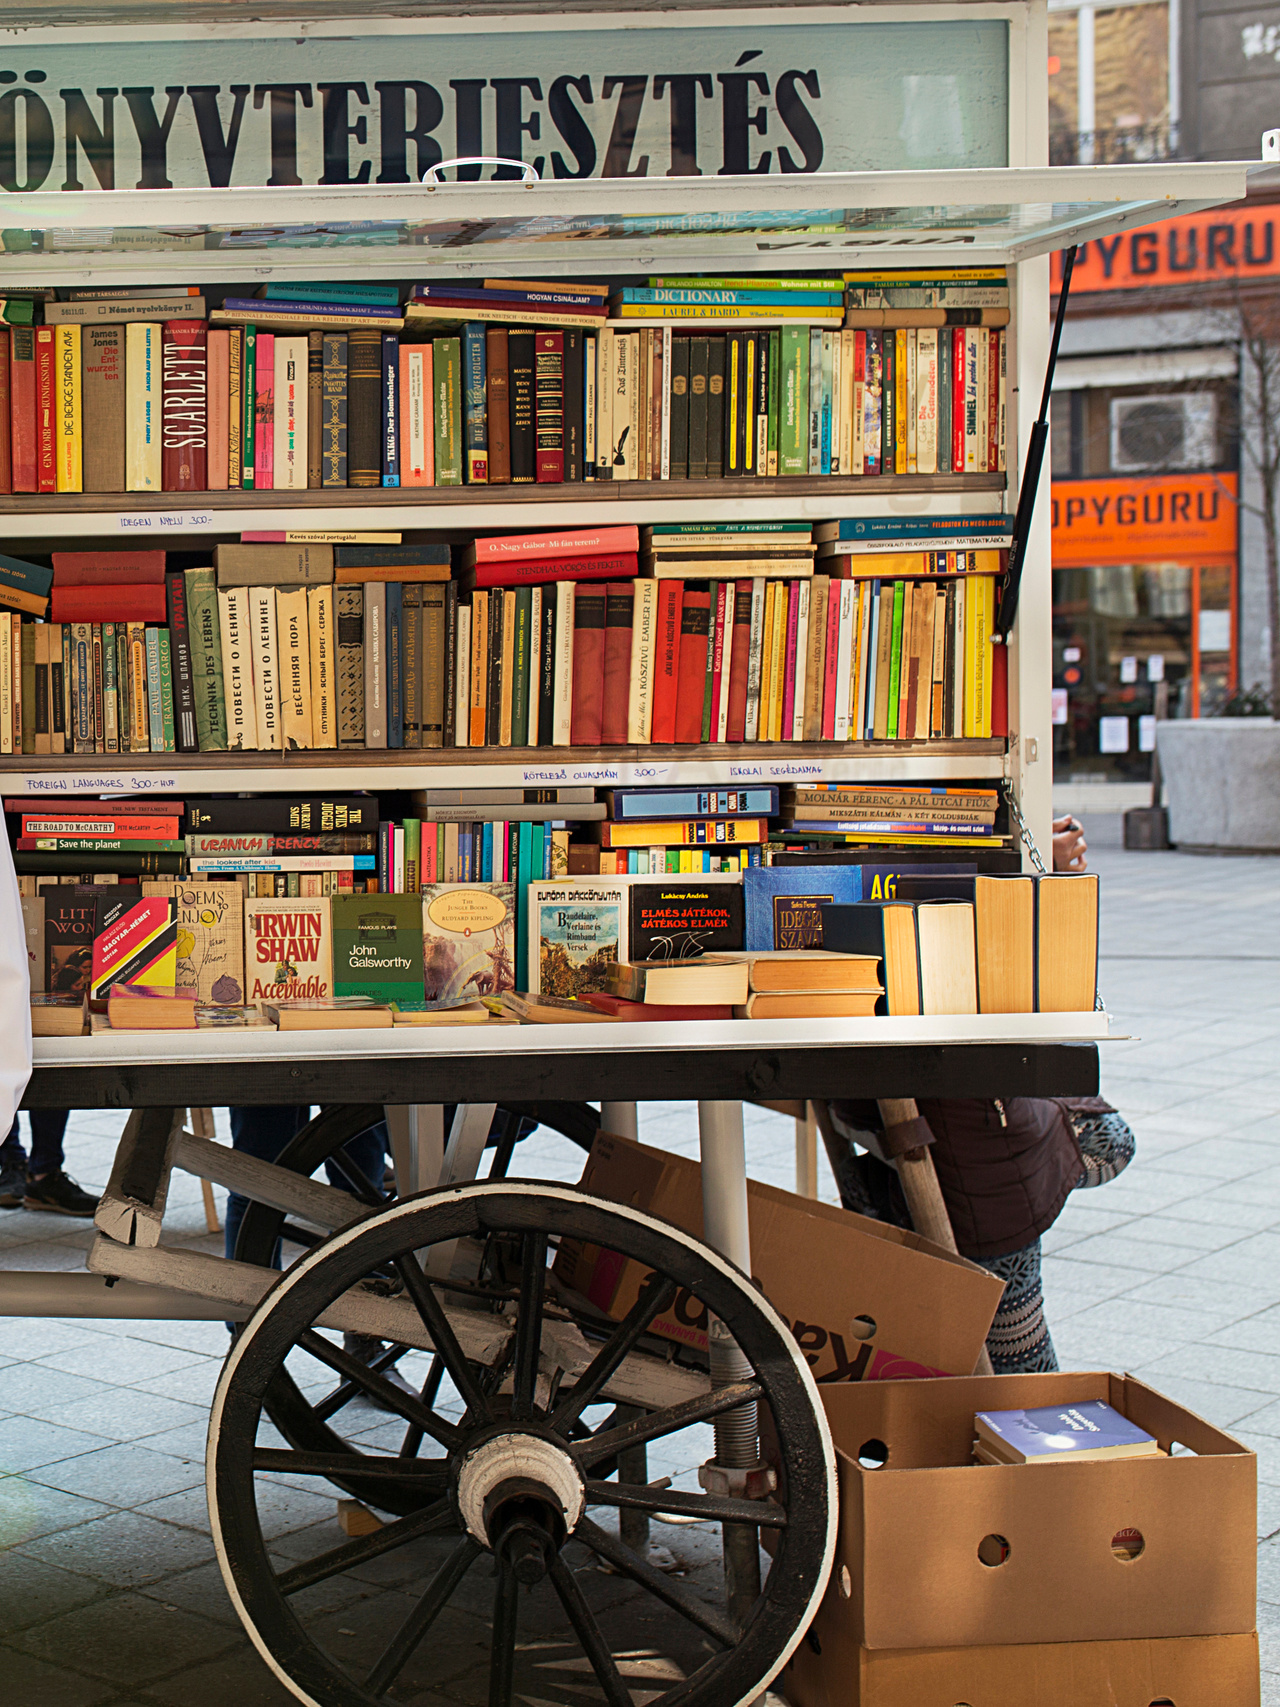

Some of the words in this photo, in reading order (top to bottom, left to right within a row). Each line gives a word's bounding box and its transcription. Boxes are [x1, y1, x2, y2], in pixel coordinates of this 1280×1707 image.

[1050, 219, 1274, 284] PYGURU
[527, 293, 552, 301] HOGYAN
[553, 294, 590, 304] CSINÁLJAM?
[654, 289, 739, 303] DICTIONARY
[90, 330, 118, 339] James
[93, 339, 118, 347] Jones
[103, 347, 118, 355] Die
[101, 355, 118, 363] Ent-
[87, 365, 118, 373] wurzel-
[104, 372, 118, 380] ten
[163, 342, 206, 448] SCARLETT
[967, 399, 976, 435] SIMMEL
[120, 516, 151, 526] IDEGEN
[160, 516, 183, 527] NYELV
[501, 542, 520, 553] Nagy
[522, 540, 546, 551] Gábor
[549, 539, 560, 548] Mi
[561, 538, 573, 548] fán
[574, 537, 600, 547] terem?
[642, 583, 651, 604] FIAI
[172, 578, 185, 631] УРАГАН
[227, 595, 239, 645] ЛЕНИНЕ
[641, 606, 651, 642] EMBER
[202, 608, 213, 649] LEBENS
[289, 616, 299, 648] ПОРА
[178, 644, 188, 680] ШПАНОВ
[205, 655, 215, 675] DES
[639, 646, 648, 689] KŐSZÍVŰ
[291, 656, 303, 715] ВЕСЕННЯЯ
[180, 685, 190, 706] НИК.
[232, 666, 244, 725] ПОВЕСТИ
[206, 681, 220, 733] TECHNIK
[524, 770, 568, 781] KÖTELEZŐ
[730, 767, 762, 776] ISKOLAI
[770, 765, 823, 776] SEGÉDANYAG
[26, 779, 67, 790] FOREIGN
[72, 779, 124, 788] LANGUAGES
[804, 792, 849, 804] MOLNÁR
[853, 795, 894, 805] FERENC
[899, 796, 906, 805] A
[910, 794, 929, 806] PÁL
[932, 797, 962, 806] UTCAI
[965, 797, 990, 807] FIÚK
[290, 806, 299, 827] SMITH
[301, 803, 311, 830] MURRAY
[321, 801, 334, 831] JUGGLER
[335, 804, 347, 828] DEVILS
[349, 808, 361, 824] THE
[28, 823, 42, 831] THE
[43, 823, 63, 831] ROAD
[64, 823, 74, 831] TO
[75, 823, 113, 832] McCARTHY
[59, 840, 79, 848] Save
[80, 840, 94, 848] the
[95, 840, 121, 850] planet
[200, 838, 263, 852] URANIUM
[266, 836, 321, 850] FRENZY
[174, 884, 224, 905] POEMS
[537, 889, 566, 901] EURÓPA
[661, 892, 686, 900] Lukácsy
[686, 892, 709, 900] András
[177, 908, 223, 924] ENJOY
[641, 908, 679, 918] ELMÉS
[680, 907, 731, 918] JÁTÉKOK,
[254, 913, 322, 938] IRWIN
[566, 922, 593, 931] Verlaine
[594, 922, 601, 931] és
[641, 919, 689, 929] JÁTÉKOS
[691, 918, 728, 928] ELMÉK
[566, 932, 597, 941] Rimbaud
[256, 937, 321, 964] SHAW
[349, 944, 377, 956] John
[566, 943, 588, 951] Versek
[349, 957, 412, 971] Galsworthy
[251, 975, 327, 1000] Acceptable
